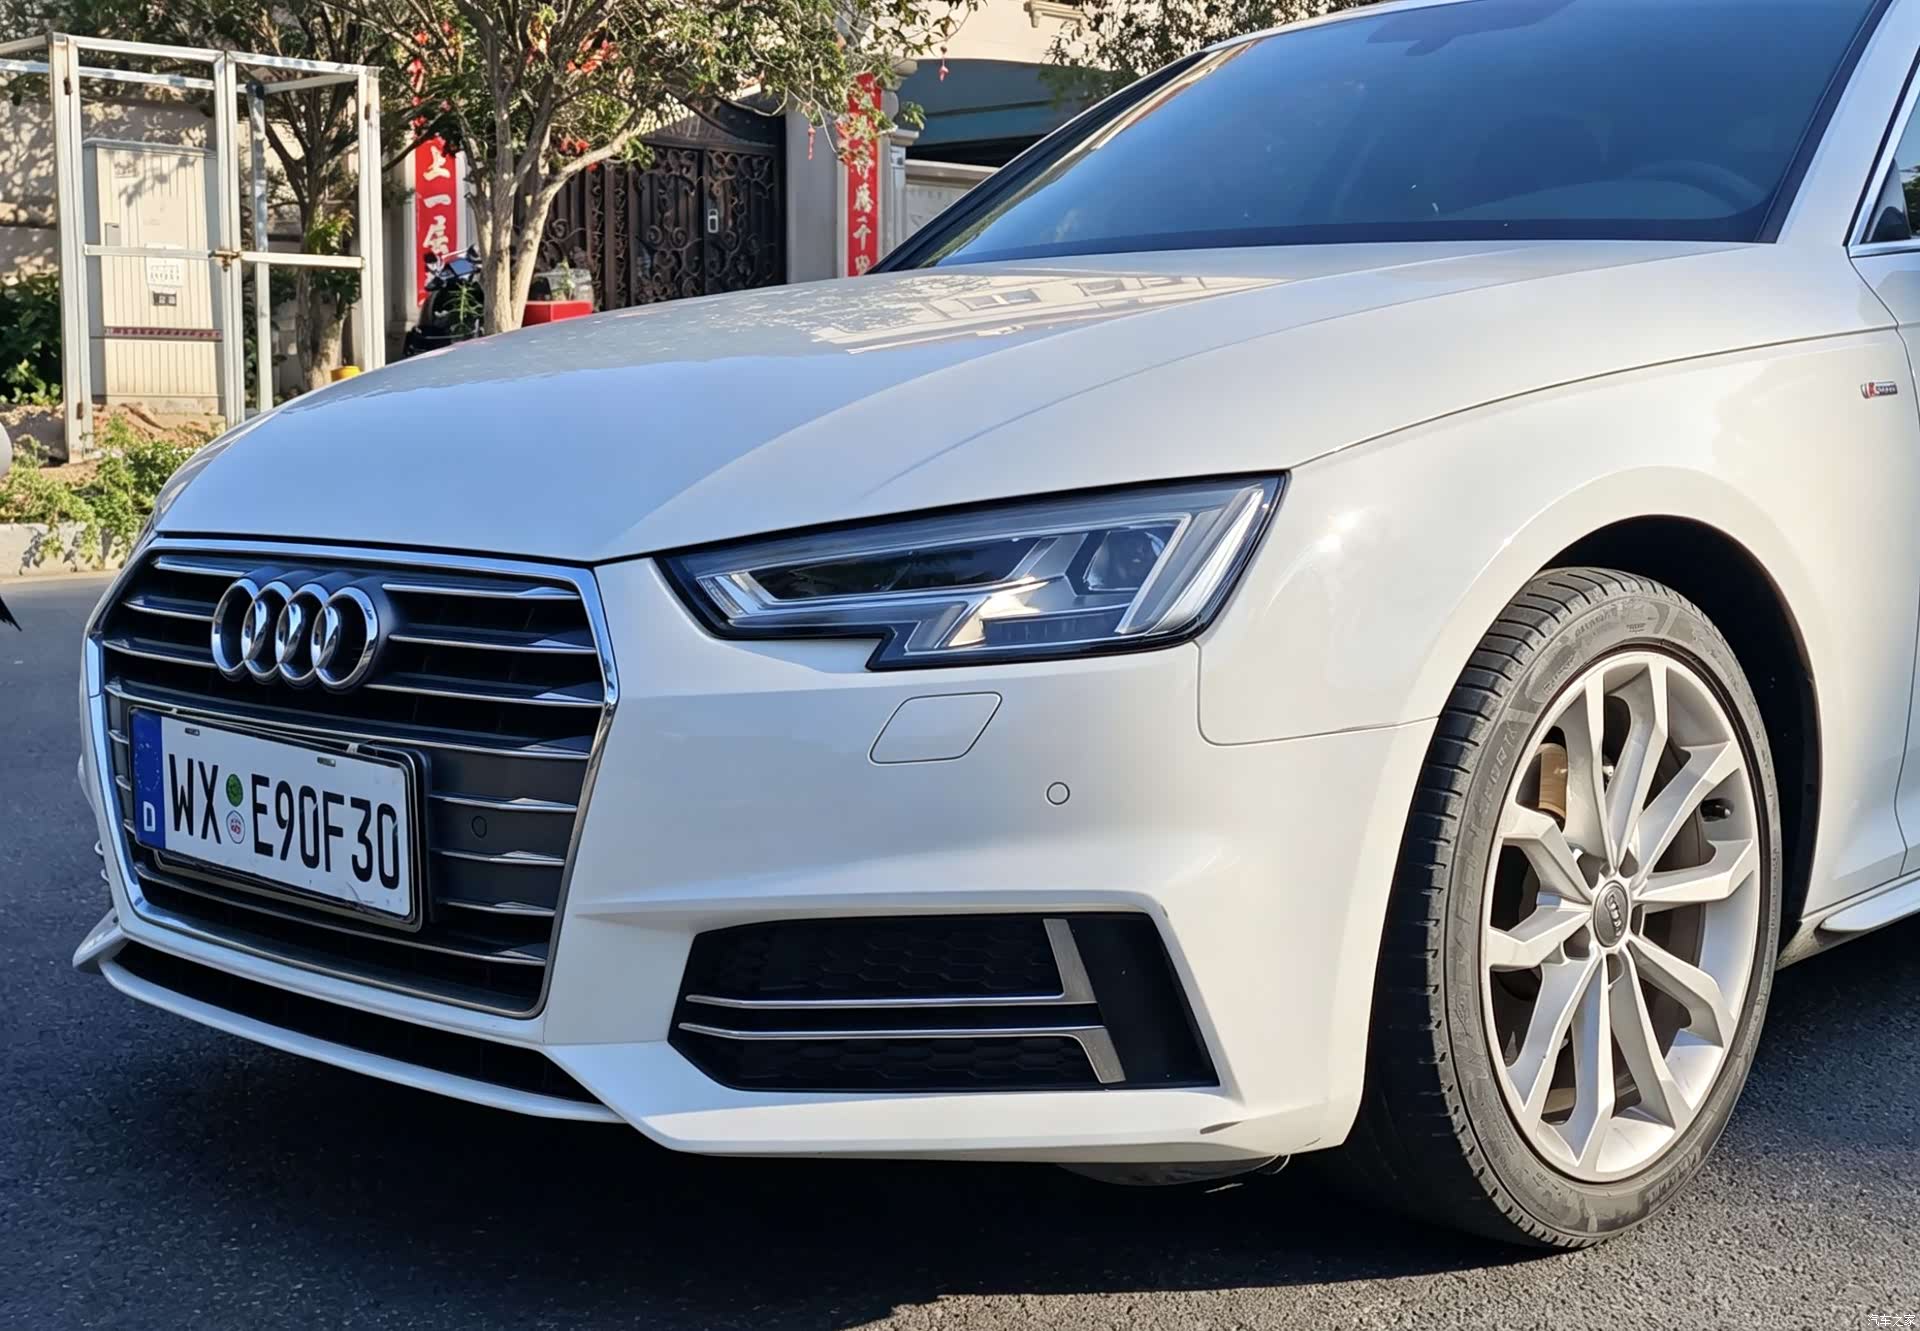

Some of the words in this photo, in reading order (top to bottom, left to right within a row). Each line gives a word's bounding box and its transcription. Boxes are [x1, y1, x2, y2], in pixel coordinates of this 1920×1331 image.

[143, 801, 156, 832] D
[168, 753, 222, 845] WX
[250, 773, 401, 890] E90F30
